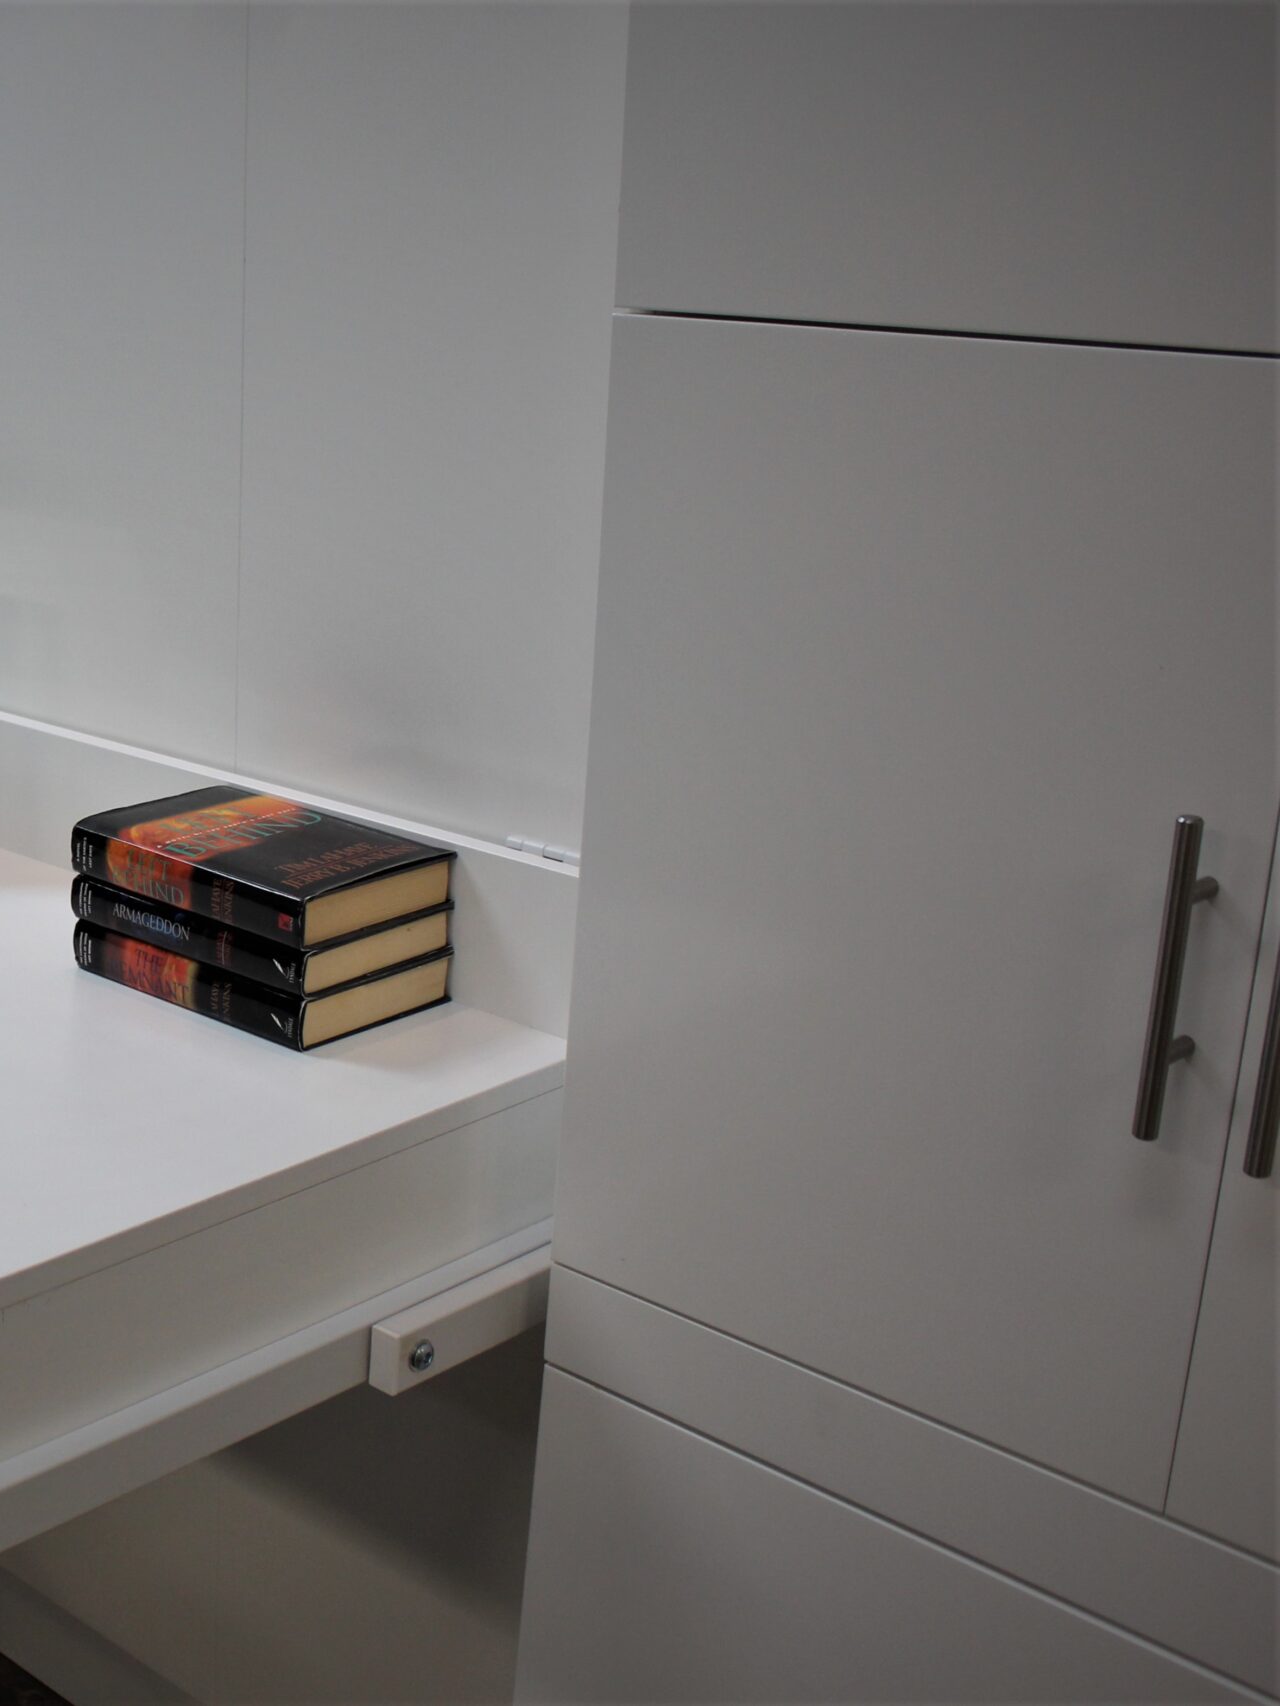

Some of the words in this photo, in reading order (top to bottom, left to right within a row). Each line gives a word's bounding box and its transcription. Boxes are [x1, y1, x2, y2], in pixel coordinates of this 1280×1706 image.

[164, 810, 323, 858] BEHIND
[128, 849, 171, 880] LEFT
[111, 865, 184, 906] BEHIND
[112, 903, 191, 941] ARMAGEDDON
[136, 949, 165, 974] THE
